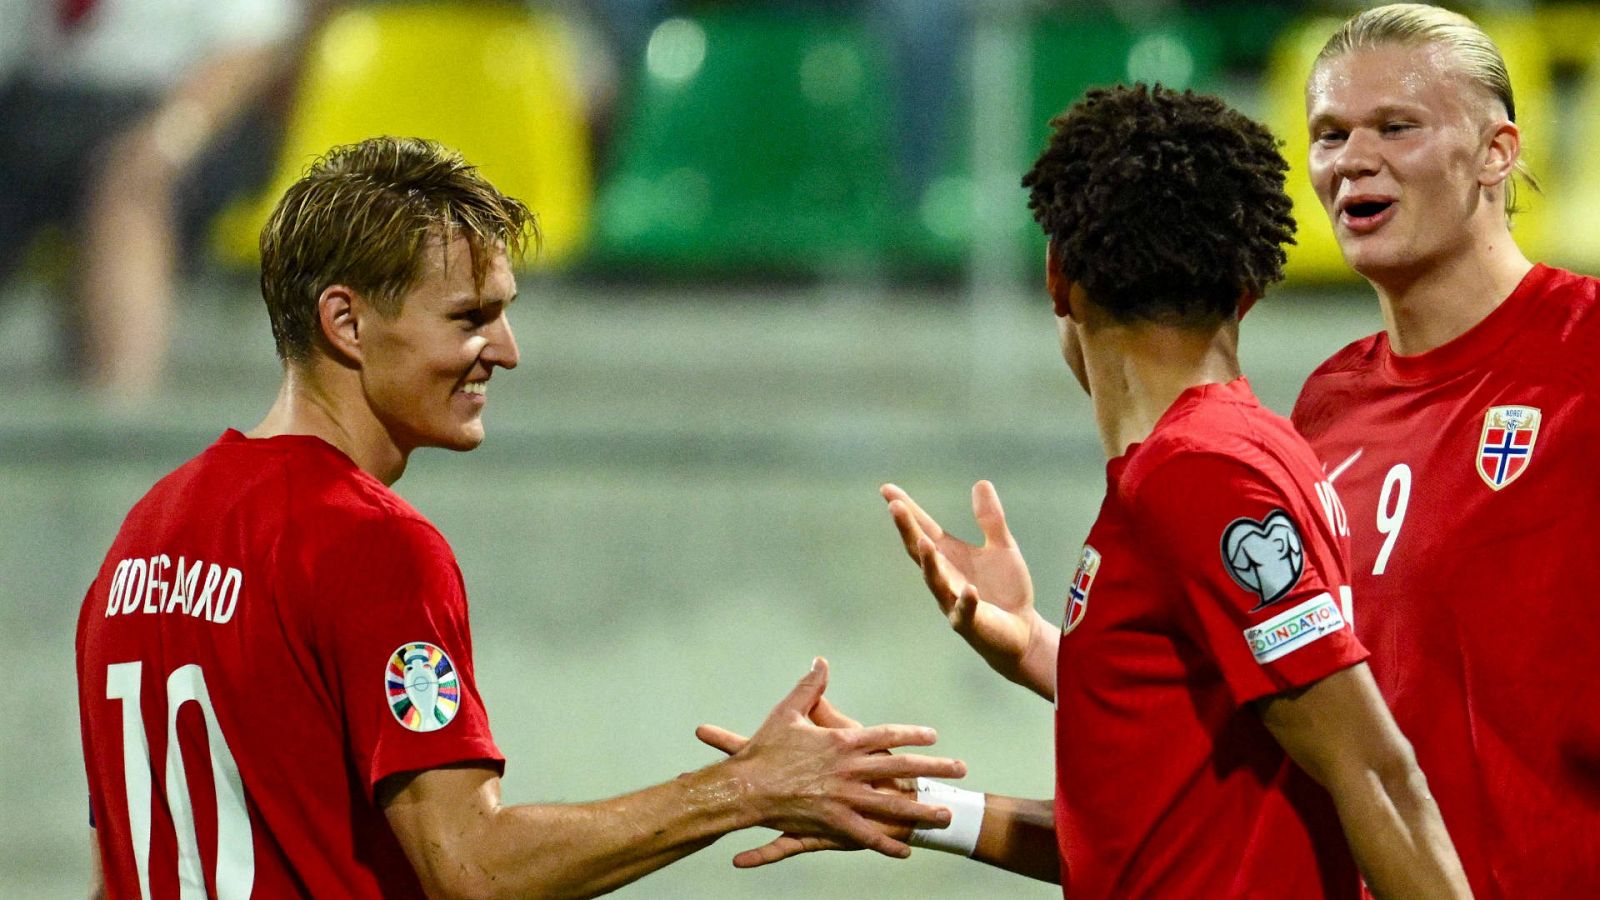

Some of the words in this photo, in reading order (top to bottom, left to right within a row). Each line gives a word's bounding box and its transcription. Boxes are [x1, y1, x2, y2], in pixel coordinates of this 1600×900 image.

[1314, 480, 1350, 537] VO
[1372, 463, 1411, 575] 9
[106, 661, 255, 900] 10
